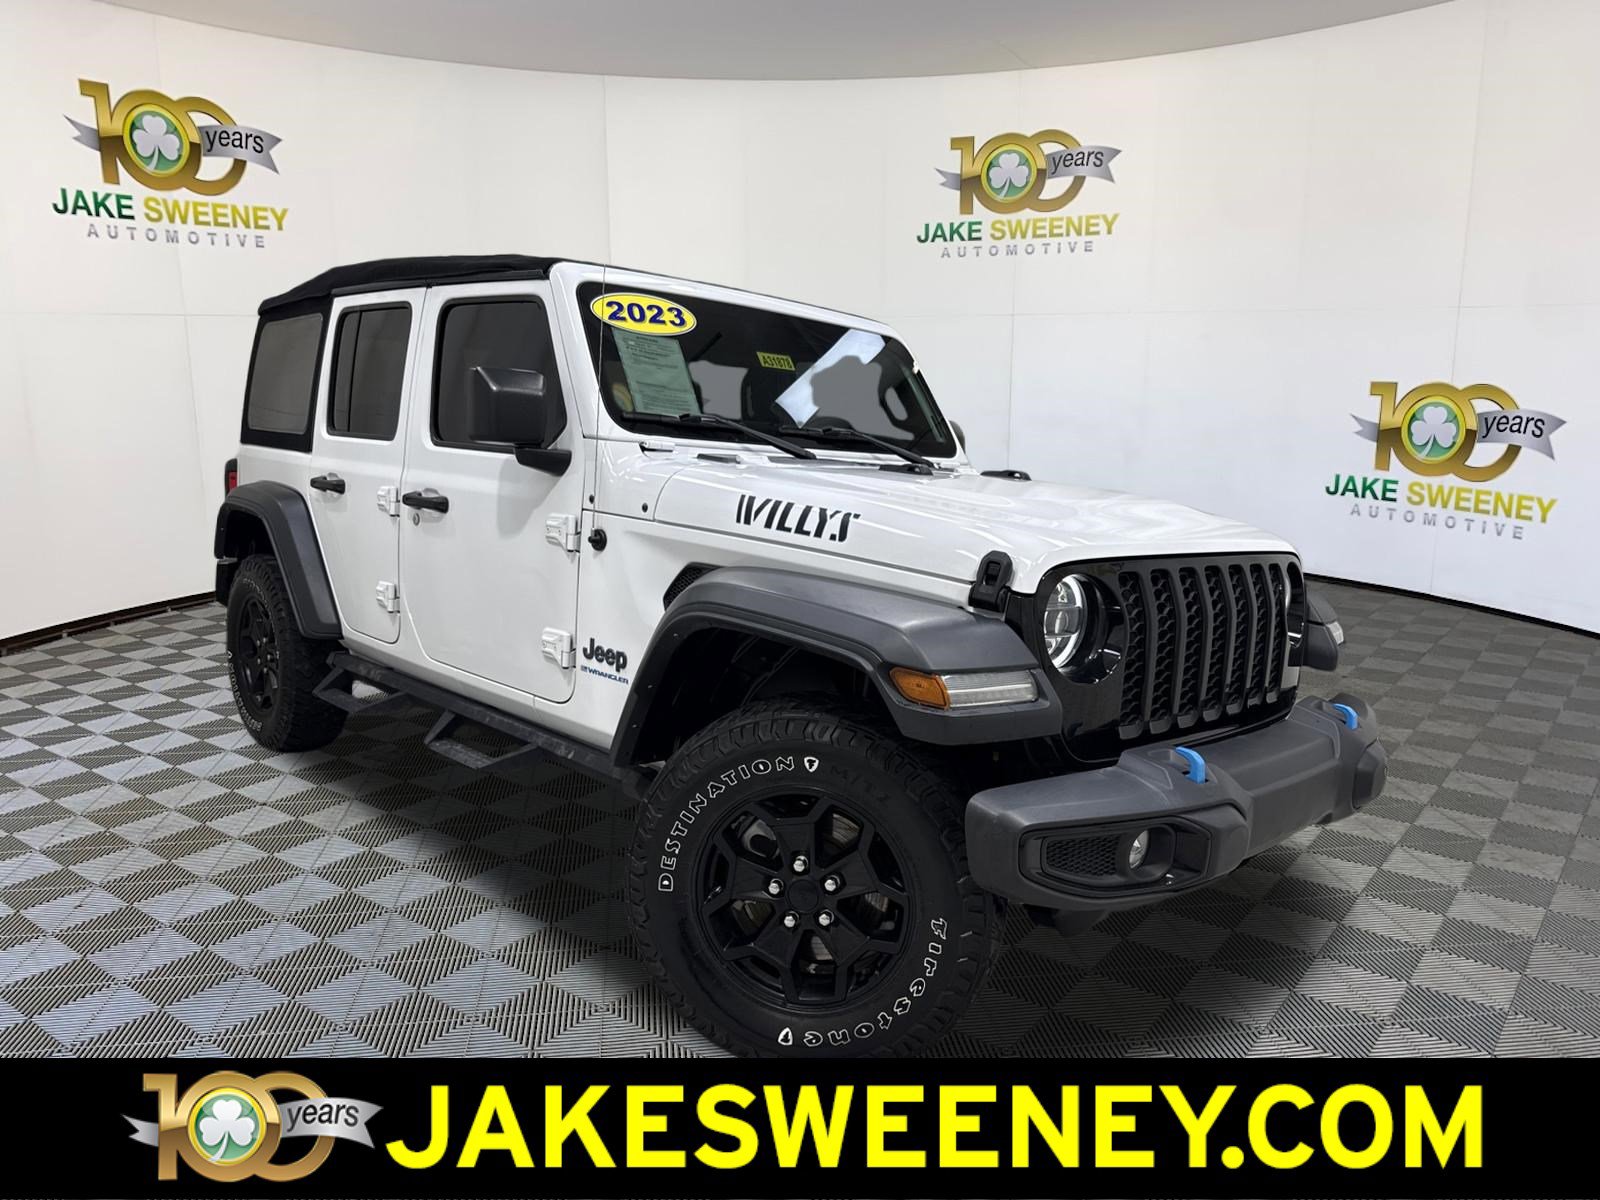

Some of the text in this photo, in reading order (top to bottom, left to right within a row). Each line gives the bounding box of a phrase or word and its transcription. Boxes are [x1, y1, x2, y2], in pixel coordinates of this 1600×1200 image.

[205, 129, 264, 154] years
[1051, 150, 1104, 174] years
[52, 188, 289, 231] JAKE SWEENEY
[87, 223, 266, 249] AUTOMOTIVE
[916, 213, 1121, 243] JAKE SWEENEY
[940, 241, 1094, 258] AUTOMOTIVE
[606, 300, 687, 328] 2023
[1482, 413, 1546, 439] years
[1325, 474, 1559, 524] JAKE SWEENEY
[736, 494, 862, 542] WILLYS
[1350, 503, 1524, 540] AUTOMOTIVE
[583, 637, 628, 672] Jeep
[658, 756, 794, 892] DESTINATION
[803, 918, 948, 1046] Firestone
